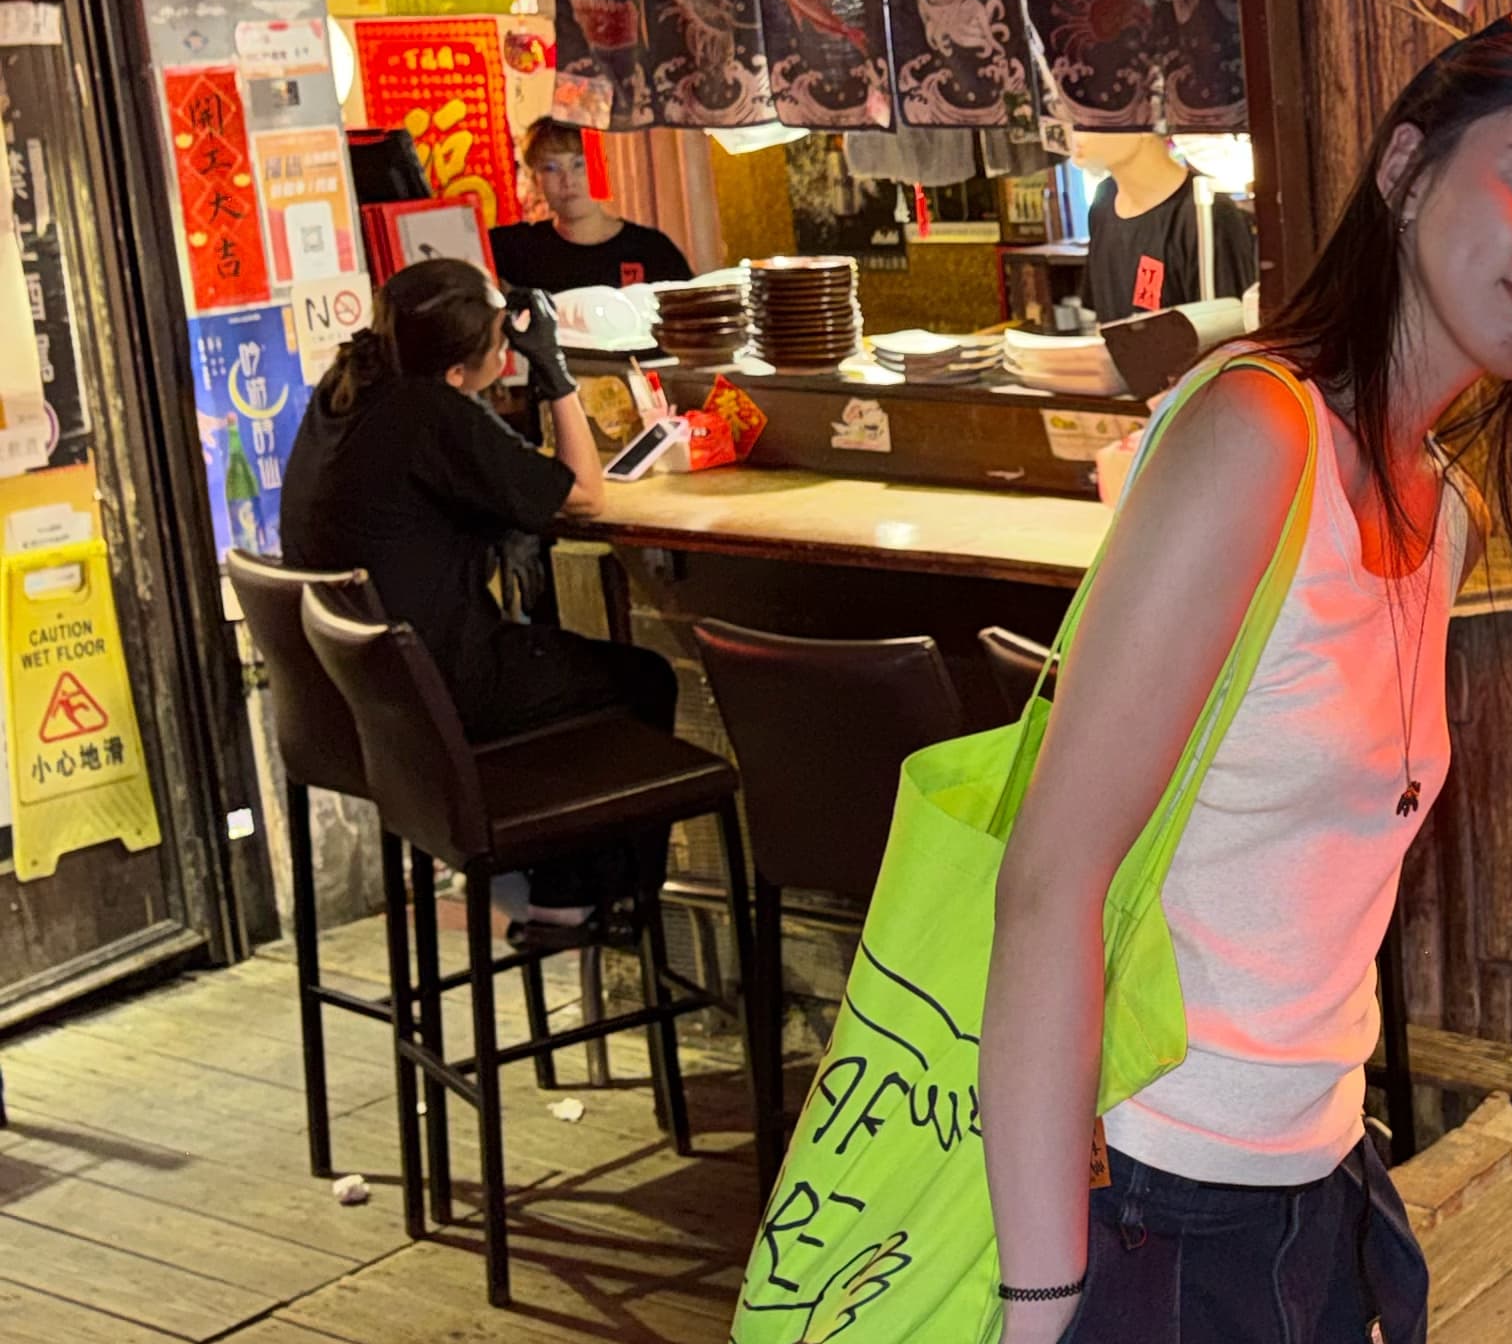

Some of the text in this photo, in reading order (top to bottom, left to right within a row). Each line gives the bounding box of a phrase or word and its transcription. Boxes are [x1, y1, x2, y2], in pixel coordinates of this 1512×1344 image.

[188, 93, 246, 282] 開工大吉
[28, 620, 93, 647] CAUTION
[20, 638, 106, 670] WET FLOOR
[31, 736, 124, 784] 小心地滑
